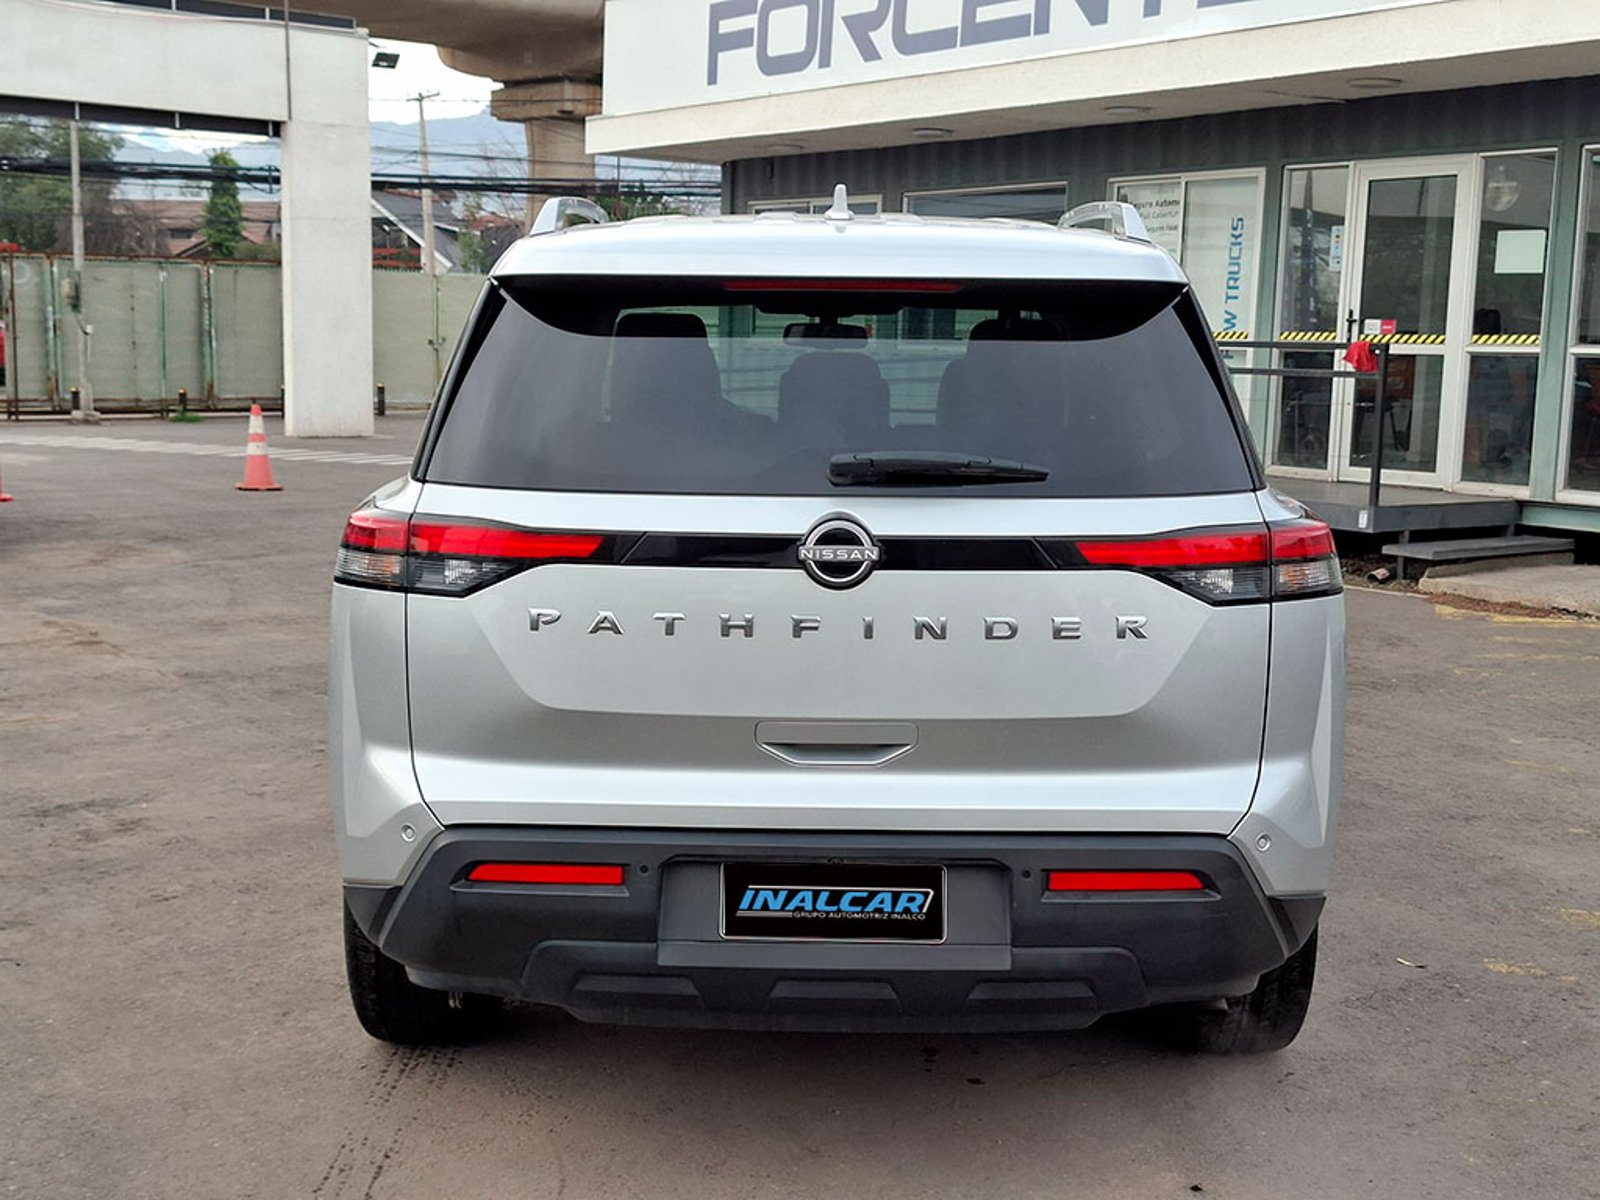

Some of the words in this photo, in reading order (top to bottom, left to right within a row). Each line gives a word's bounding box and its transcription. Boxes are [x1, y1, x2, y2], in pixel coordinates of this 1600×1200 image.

[1225, 217, 1244, 304] TRUCKS
[1221, 310, 1237, 360] FW
[801, 549, 877, 560] NISSAN
[528, 606, 1149, 641] PATHFINDER
[738, 889, 926, 914] INALCAR
[793, 911, 826, 919] GRUPO
[828, 911, 888, 920] AUTOMOTRIZ
[890, 913, 926, 921] INALCO
